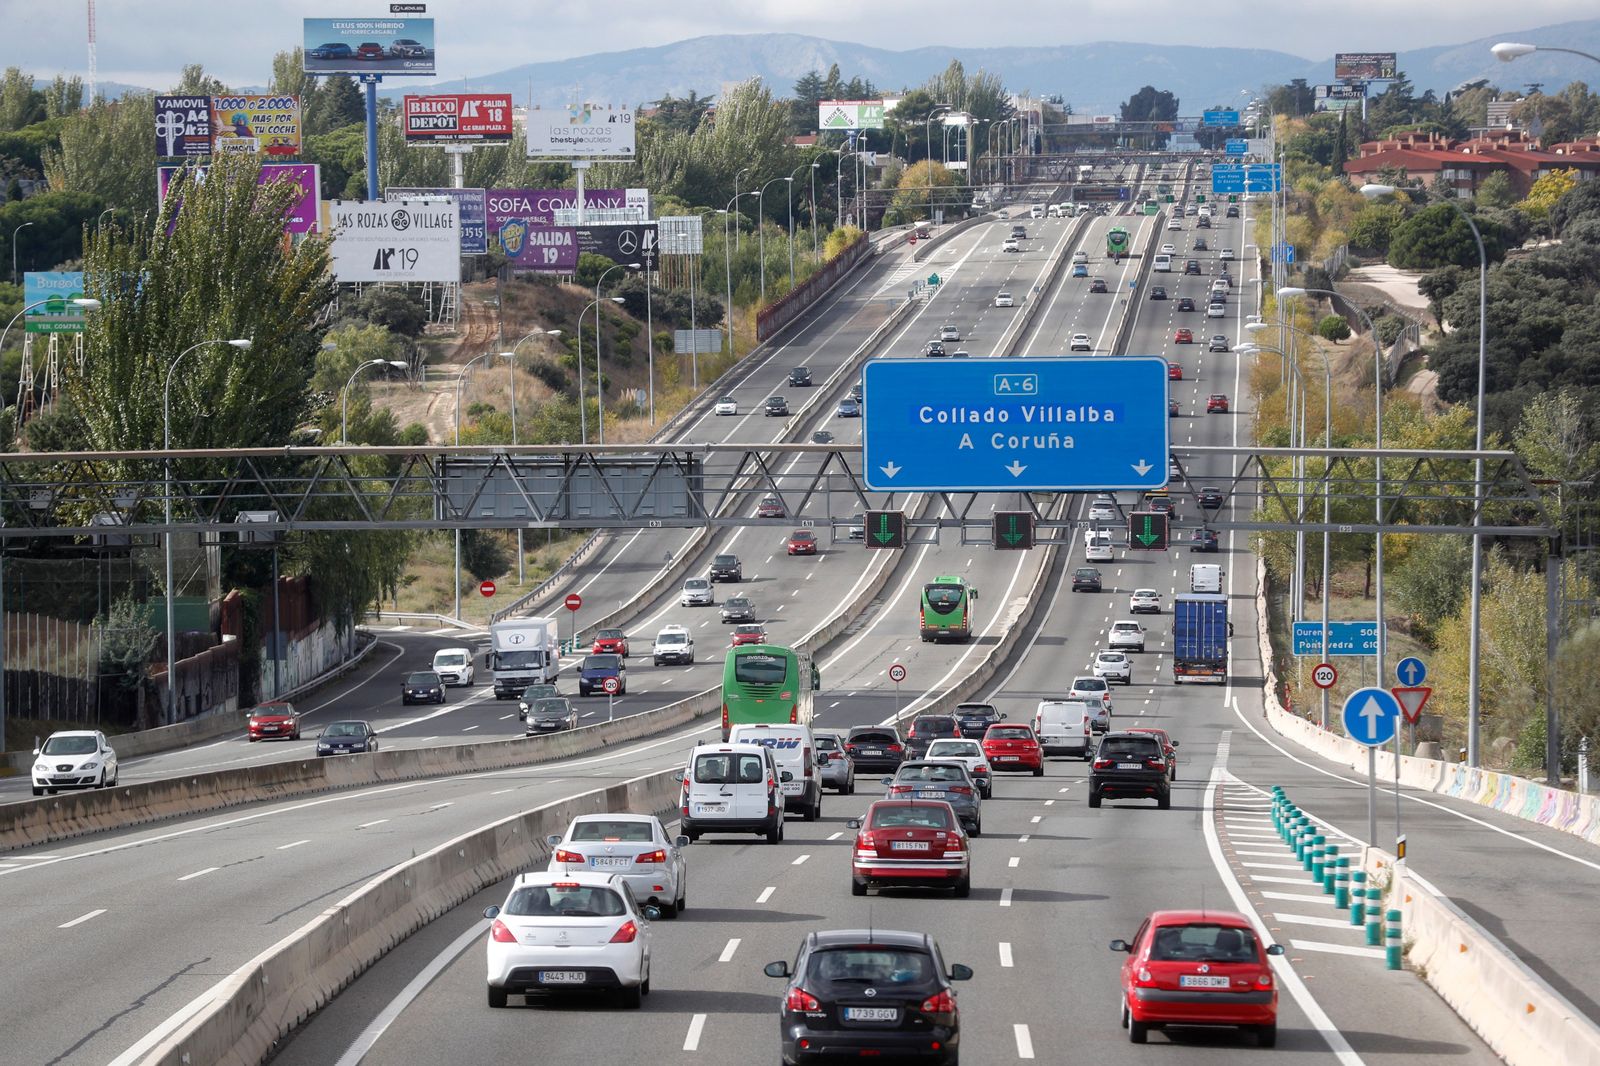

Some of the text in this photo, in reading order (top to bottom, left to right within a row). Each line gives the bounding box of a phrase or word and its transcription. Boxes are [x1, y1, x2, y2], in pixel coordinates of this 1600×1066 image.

[158, 99, 208, 108] YAMOVIL
[214, 98, 246, 110] 1.000
[410, 102, 455, 113] BRICO
[187, 110, 208, 122] A4
[252, 114, 292, 123] MAS POR
[488, 109, 503, 122] 18
[620, 114, 631, 123] 19
[823, 111, 837, 126] LEROY
[836, 107, 854, 125] MERLIN
[550, 125, 612, 135] las rozas
[489, 198, 532, 213] SOFA
[358, 213, 388, 228] ROZAS
[413, 213, 453, 228] VILLAGE
[530, 232, 572, 246] SALIDA
[398, 248, 418, 270] 19
[542, 248, 558, 264] 19
[998, 378, 1034, 392] A-6
[919, 406, 1115, 423] Collado Villalba
[958, 432, 1075, 450] A Coruña
[892, 669, 902, 677] 120
[1317, 672, 1333, 681] 120
[851, 1009, 896, 1018] 1739 GGV
